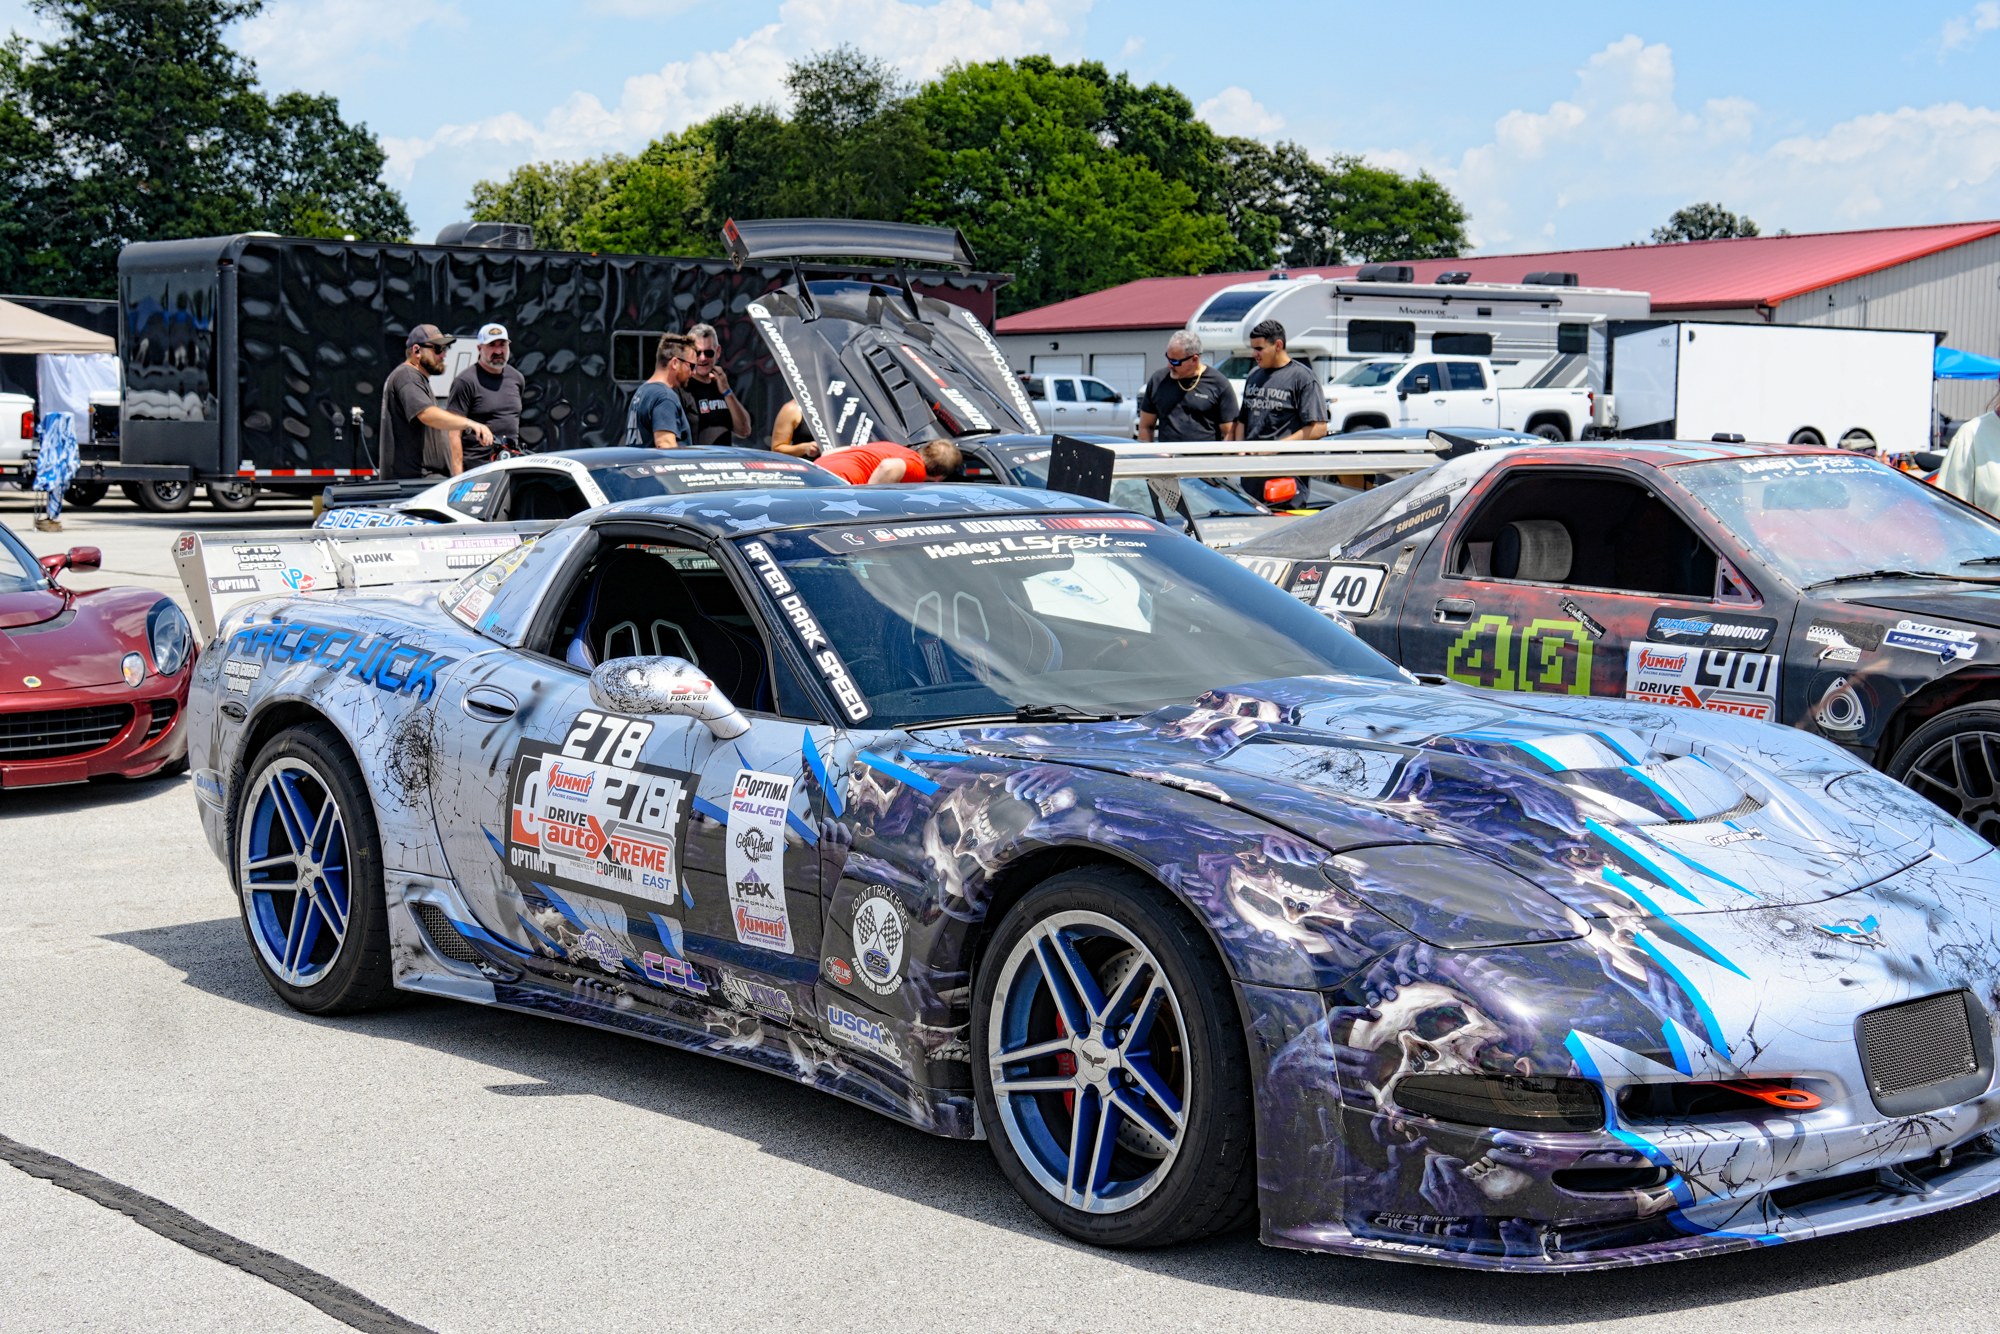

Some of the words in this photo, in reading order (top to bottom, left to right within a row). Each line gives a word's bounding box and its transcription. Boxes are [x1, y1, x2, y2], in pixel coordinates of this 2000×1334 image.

[760, 319, 834, 451] ANDERSONCOMPOSITE
[1395, 503, 1445, 533] SHOOTOUT
[892, 524, 956, 538] OPTIMA
[960, 519, 1046, 534] ULTIMATE
[1077, 519, 1124, 528] STREET
[179, 536, 195, 551] 38
[232, 545, 280, 554] AFTER
[923, 541, 1001, 559] Holley
[238, 562, 286, 571] SPEED
[240, 554, 280, 562] DARK
[352, 552, 394, 564] HAWK
[692, 559, 720, 568] OPTIM
[971, 556, 1012, 565] GRAND
[1014, 553, 1073, 561] CHAMPION
[217, 578, 256, 591] OPTIMA
[1331, 575, 1367, 607] 40
[744, 542, 792, 596] AFTER
[781, 594, 827, 650] DARK
[815, 650, 868, 721] SPEED
[1710, 623, 1769, 641] SHOOTOUT
[1638, 681, 1681, 694] DRIVE
[561, 710, 654, 769] 278
[747, 779, 790, 801] OPTIMA
[604, 777, 668, 829] 278
[732, 800, 785, 819] FALKEN
[549, 806, 587, 827] DRIVE
[511, 847, 550, 874] OPTIMA
[603, 862, 633, 882] OPTIMA
[642, 873, 671, 892] EAST
[735, 881, 775, 900] PEAK
[731, 896, 785, 912] PERFORMANCE
[851, 886, 872, 915] JOINT
[872, 884, 894, 904] TRACK
[893, 895, 910, 934] FORCE
[866, 951, 889, 969] OSS
[643, 951, 708, 994] CCL
[851, 957, 876, 993] HONOR
[876, 974, 903, 996] RACING
[828, 1005, 884, 1045] USCA
